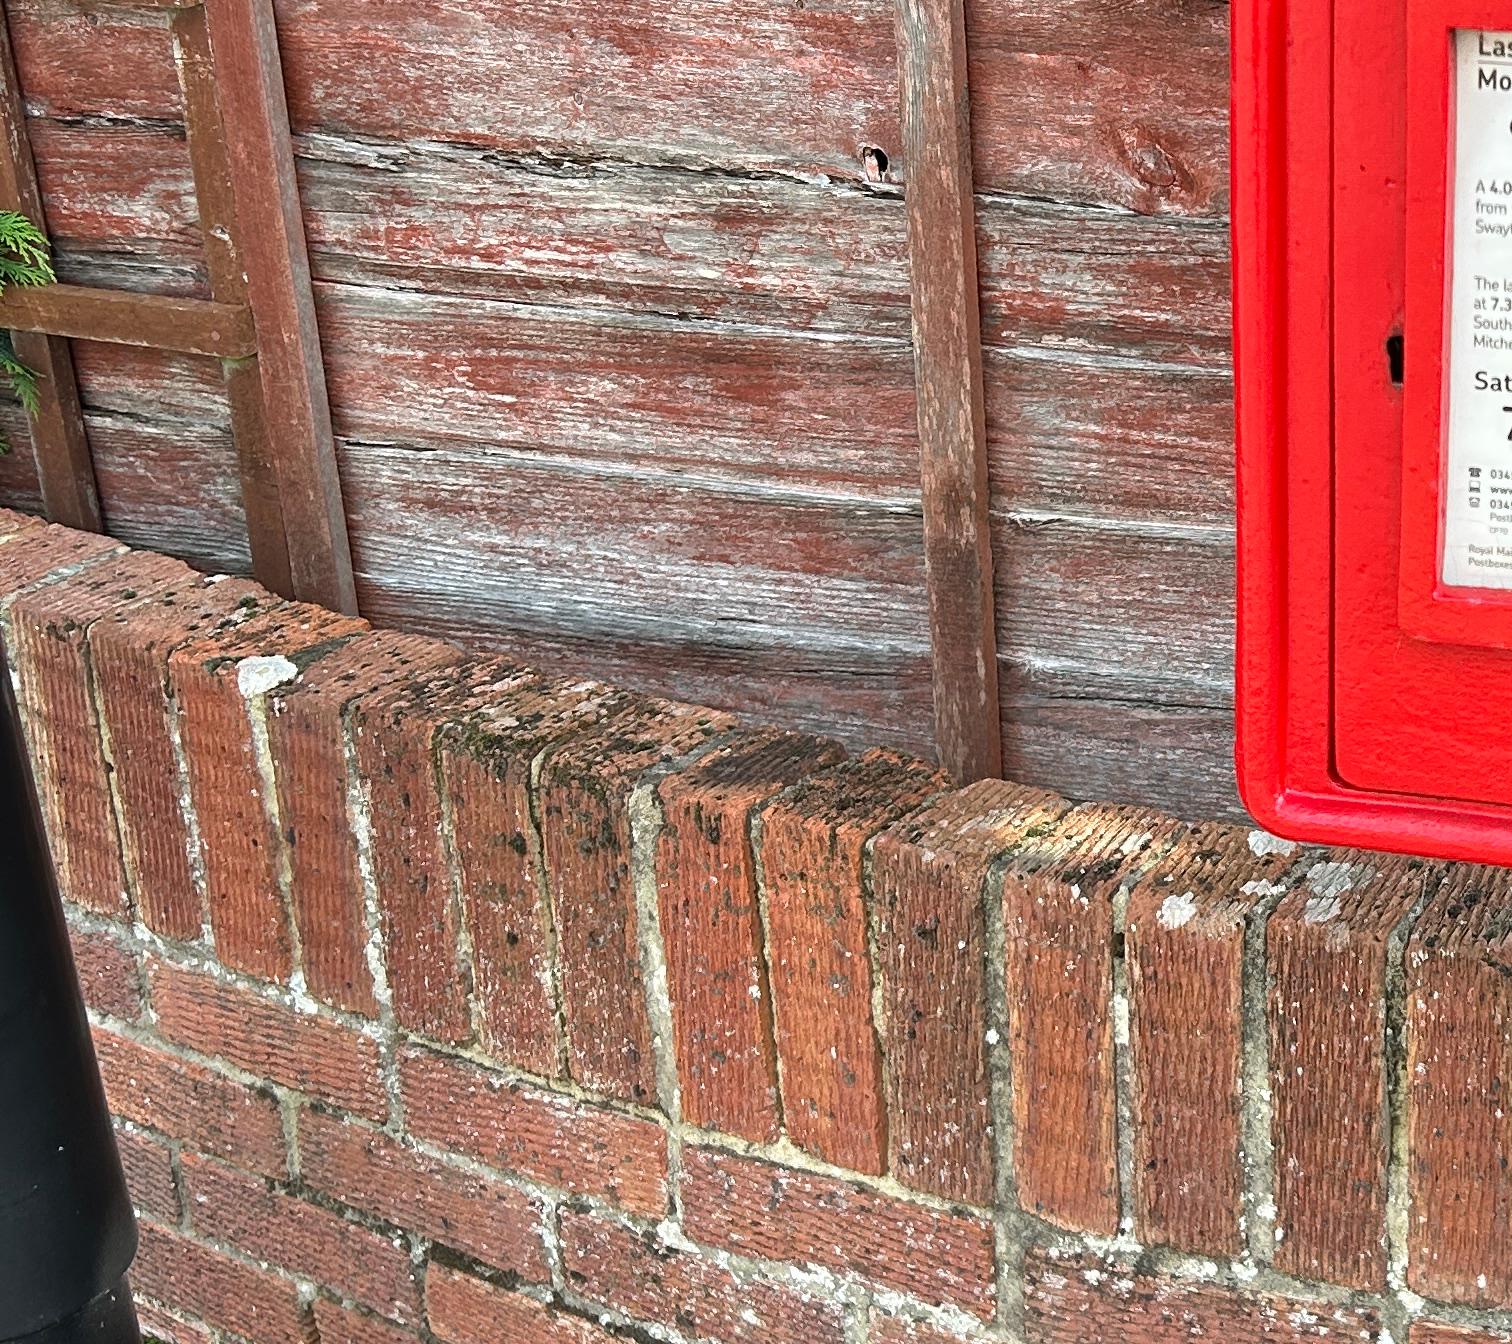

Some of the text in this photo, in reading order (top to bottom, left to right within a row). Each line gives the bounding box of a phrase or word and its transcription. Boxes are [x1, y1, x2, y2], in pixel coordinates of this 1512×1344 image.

[1476, 181, 1485, 194] A
[1476, 200, 1507, 215] from
[1474, 277, 1499, 292] The
[1473, 298, 1487, 311] at
[1468, 543, 1494, 555] Royal
